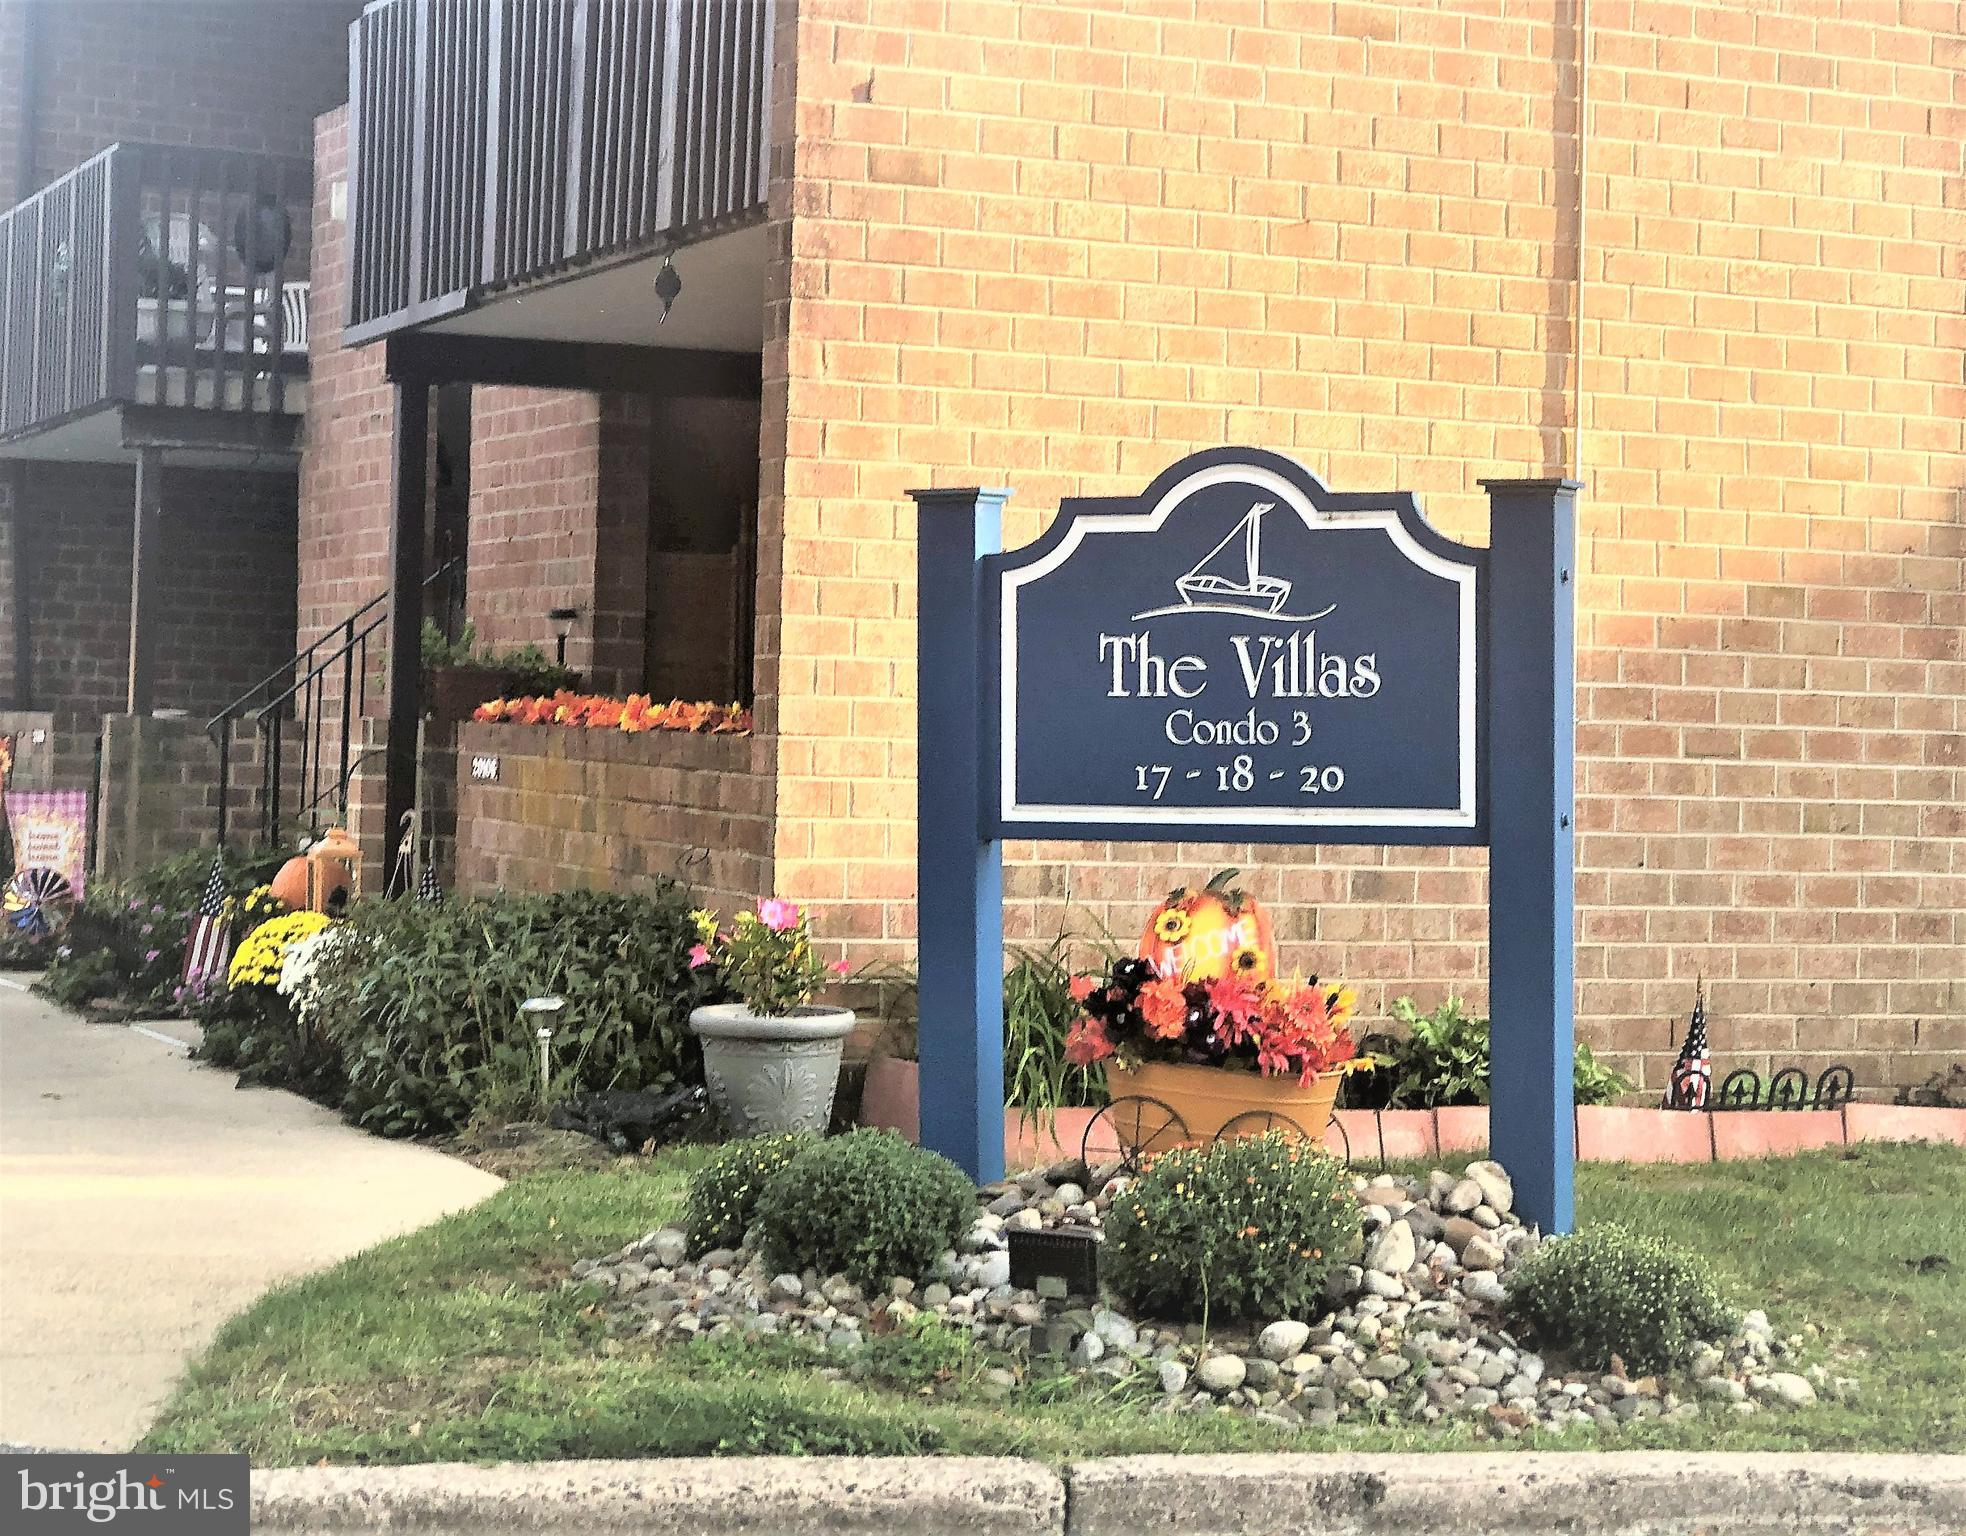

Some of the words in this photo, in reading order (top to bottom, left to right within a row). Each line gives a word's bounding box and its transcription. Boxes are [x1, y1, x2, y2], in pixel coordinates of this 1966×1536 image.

[1099, 630, 1208, 698] The
[1229, 629, 1381, 699] Villas
[1165, 706, 1279, 745] Condo
[1292, 709, 1312, 746] 3
[1135, 764, 1173, 800] 17
[1216, 754, 1254, 792] 18
[1299, 766, 1345, 795] 20
